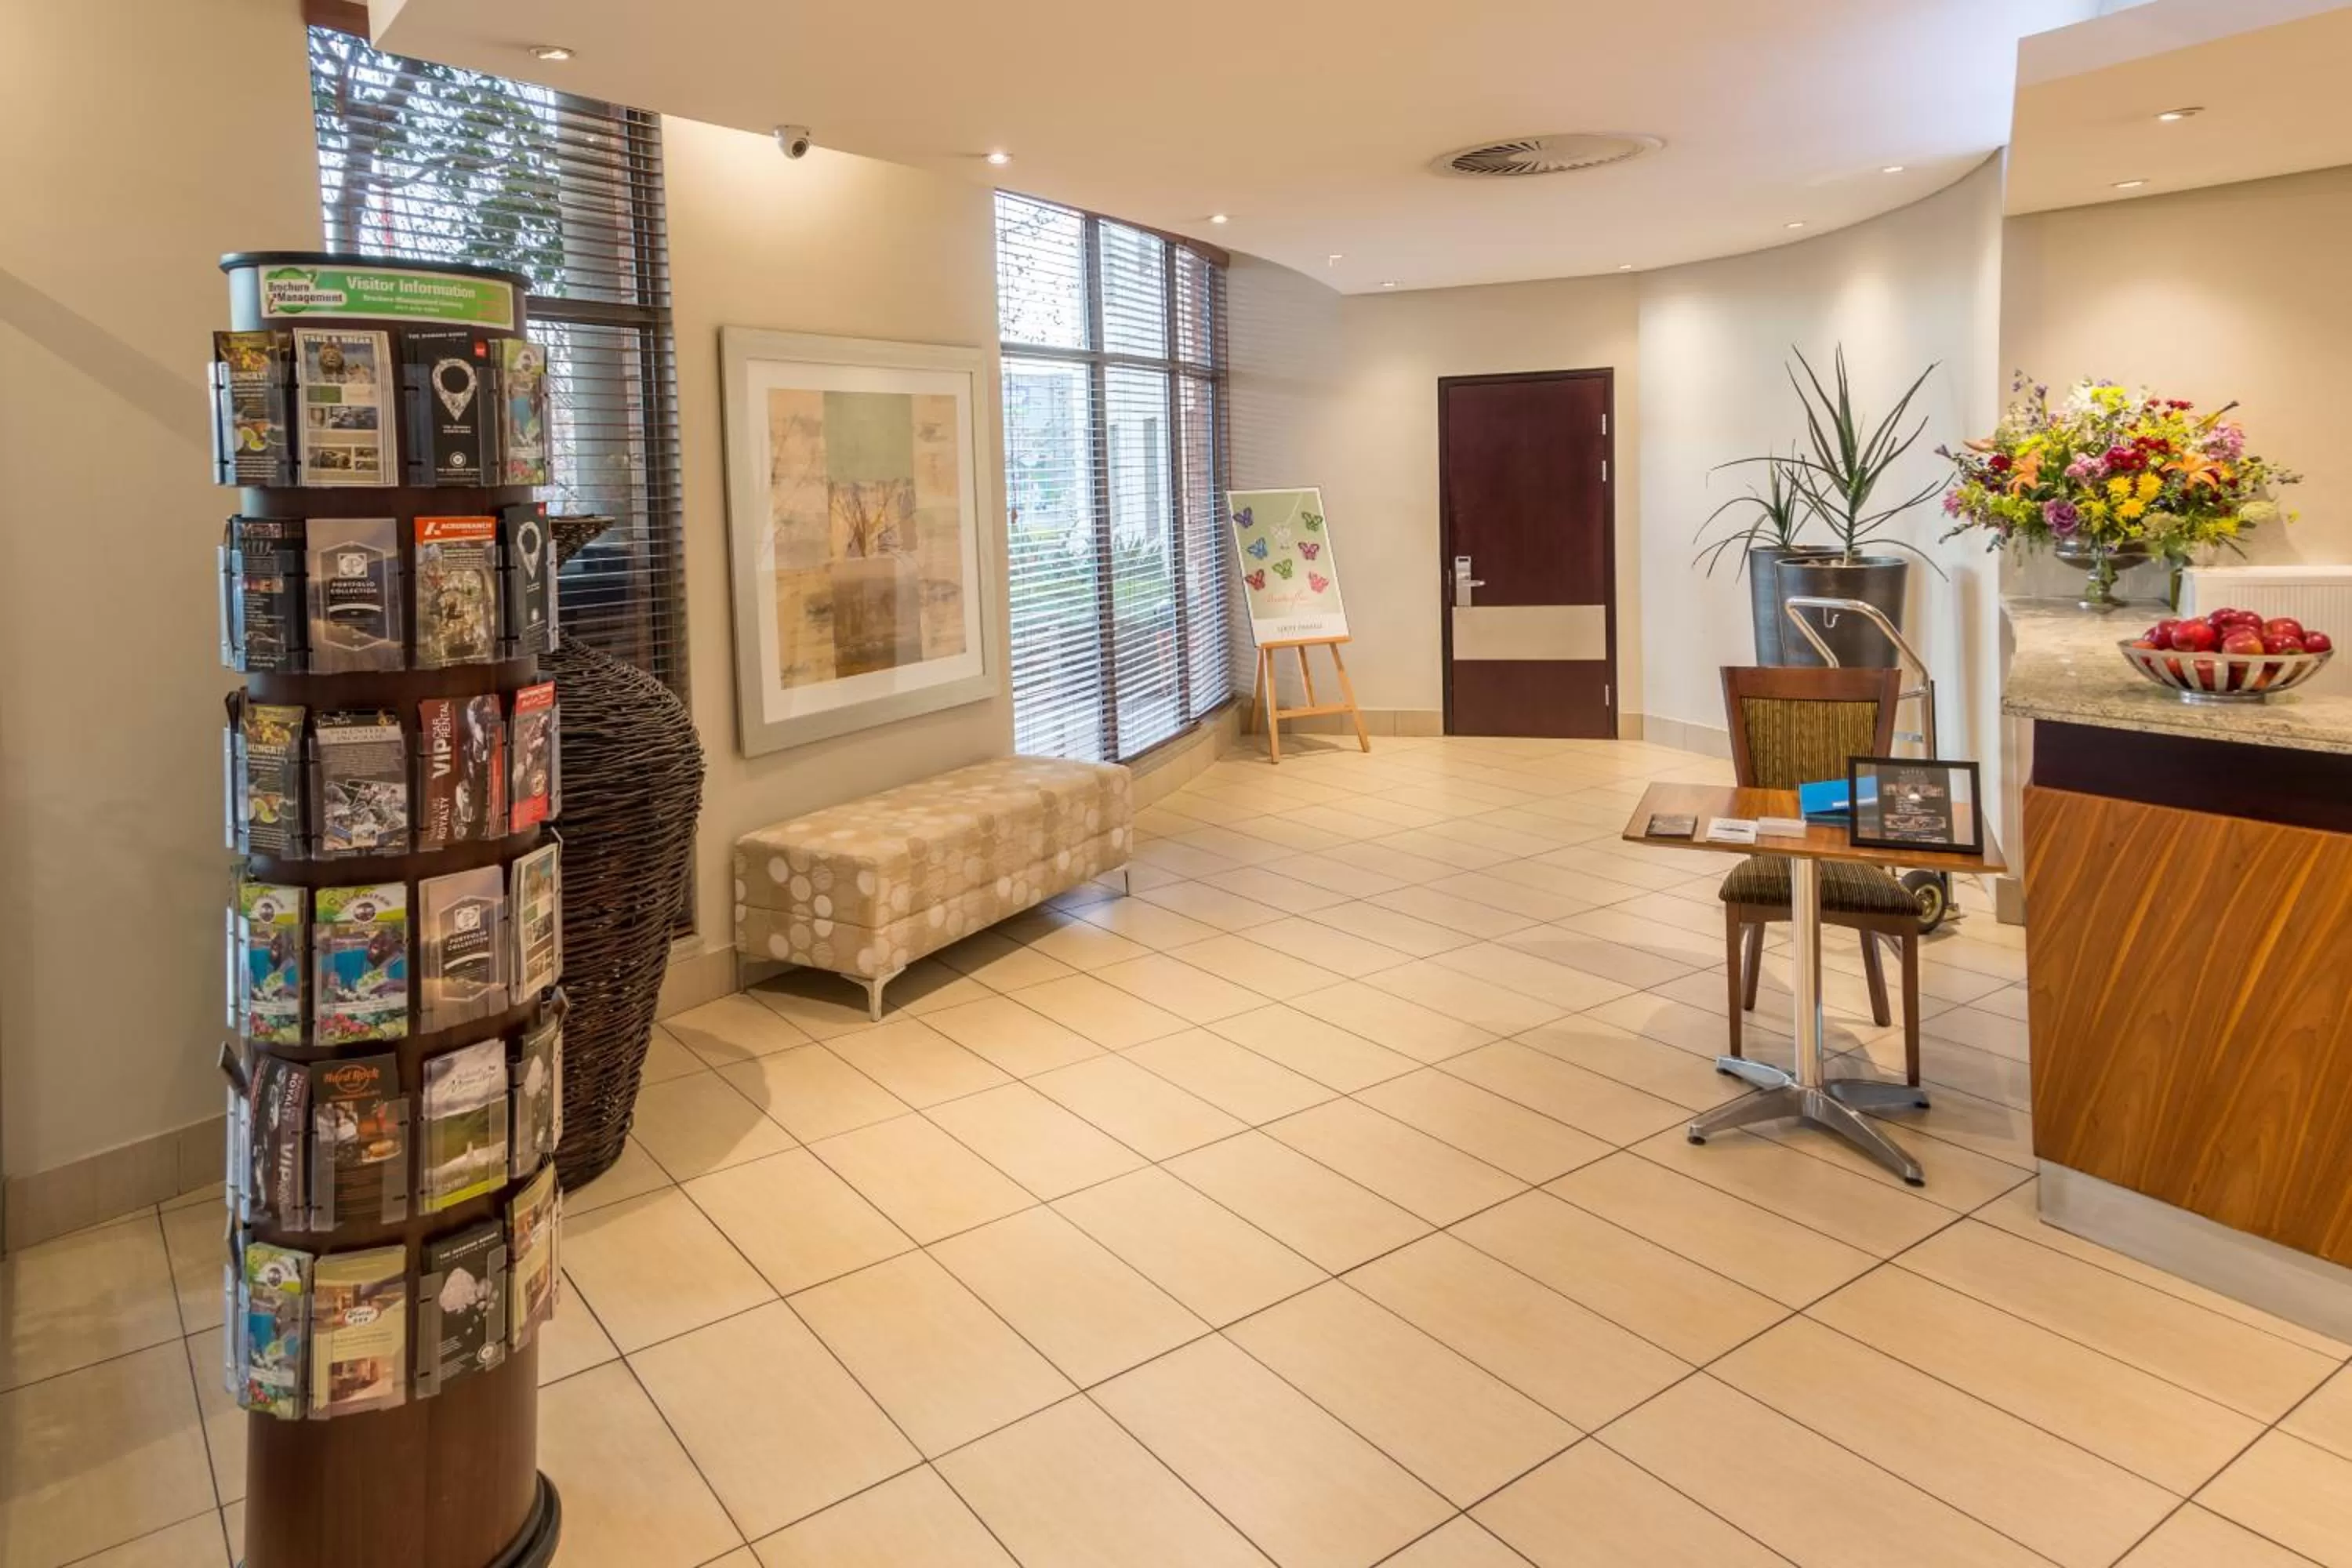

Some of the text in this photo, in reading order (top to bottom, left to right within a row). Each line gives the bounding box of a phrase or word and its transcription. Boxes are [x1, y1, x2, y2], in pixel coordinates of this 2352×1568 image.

[267, 281, 310, 292] Brochure
[278, 292, 343, 304] Management
[347, 275, 477, 299] Visitor Information
[440, 701, 452, 739] RENTAL
[432, 717, 452, 779] VIP CAR
[437, 797, 450, 841] ROYALTY
[447, 936, 489, 951] COLLECTION
[449, 931, 487, 944] PORTFOLIO
[323, 1067, 379, 1084] Hard Rock
[281, 1072, 299, 1122] ROYALTY
[279, 1142, 295, 1181] VIP
